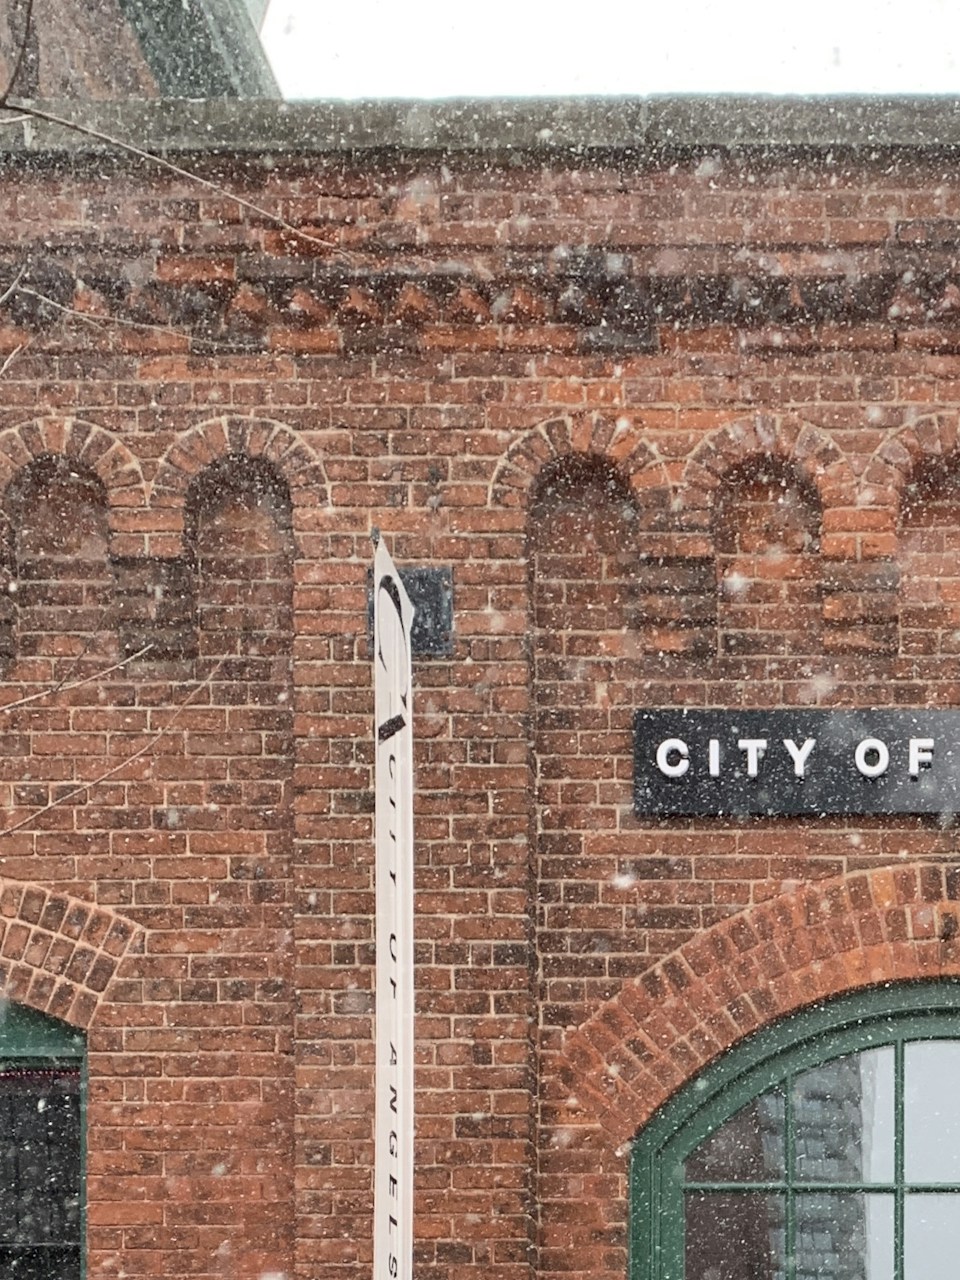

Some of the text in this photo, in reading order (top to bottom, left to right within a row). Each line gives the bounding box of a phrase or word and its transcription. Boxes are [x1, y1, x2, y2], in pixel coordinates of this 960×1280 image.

[655, 737, 816, 780] CITY
[854, 736, 935, 779] OF
[388, 1041, 399, 1279] ANGELS
